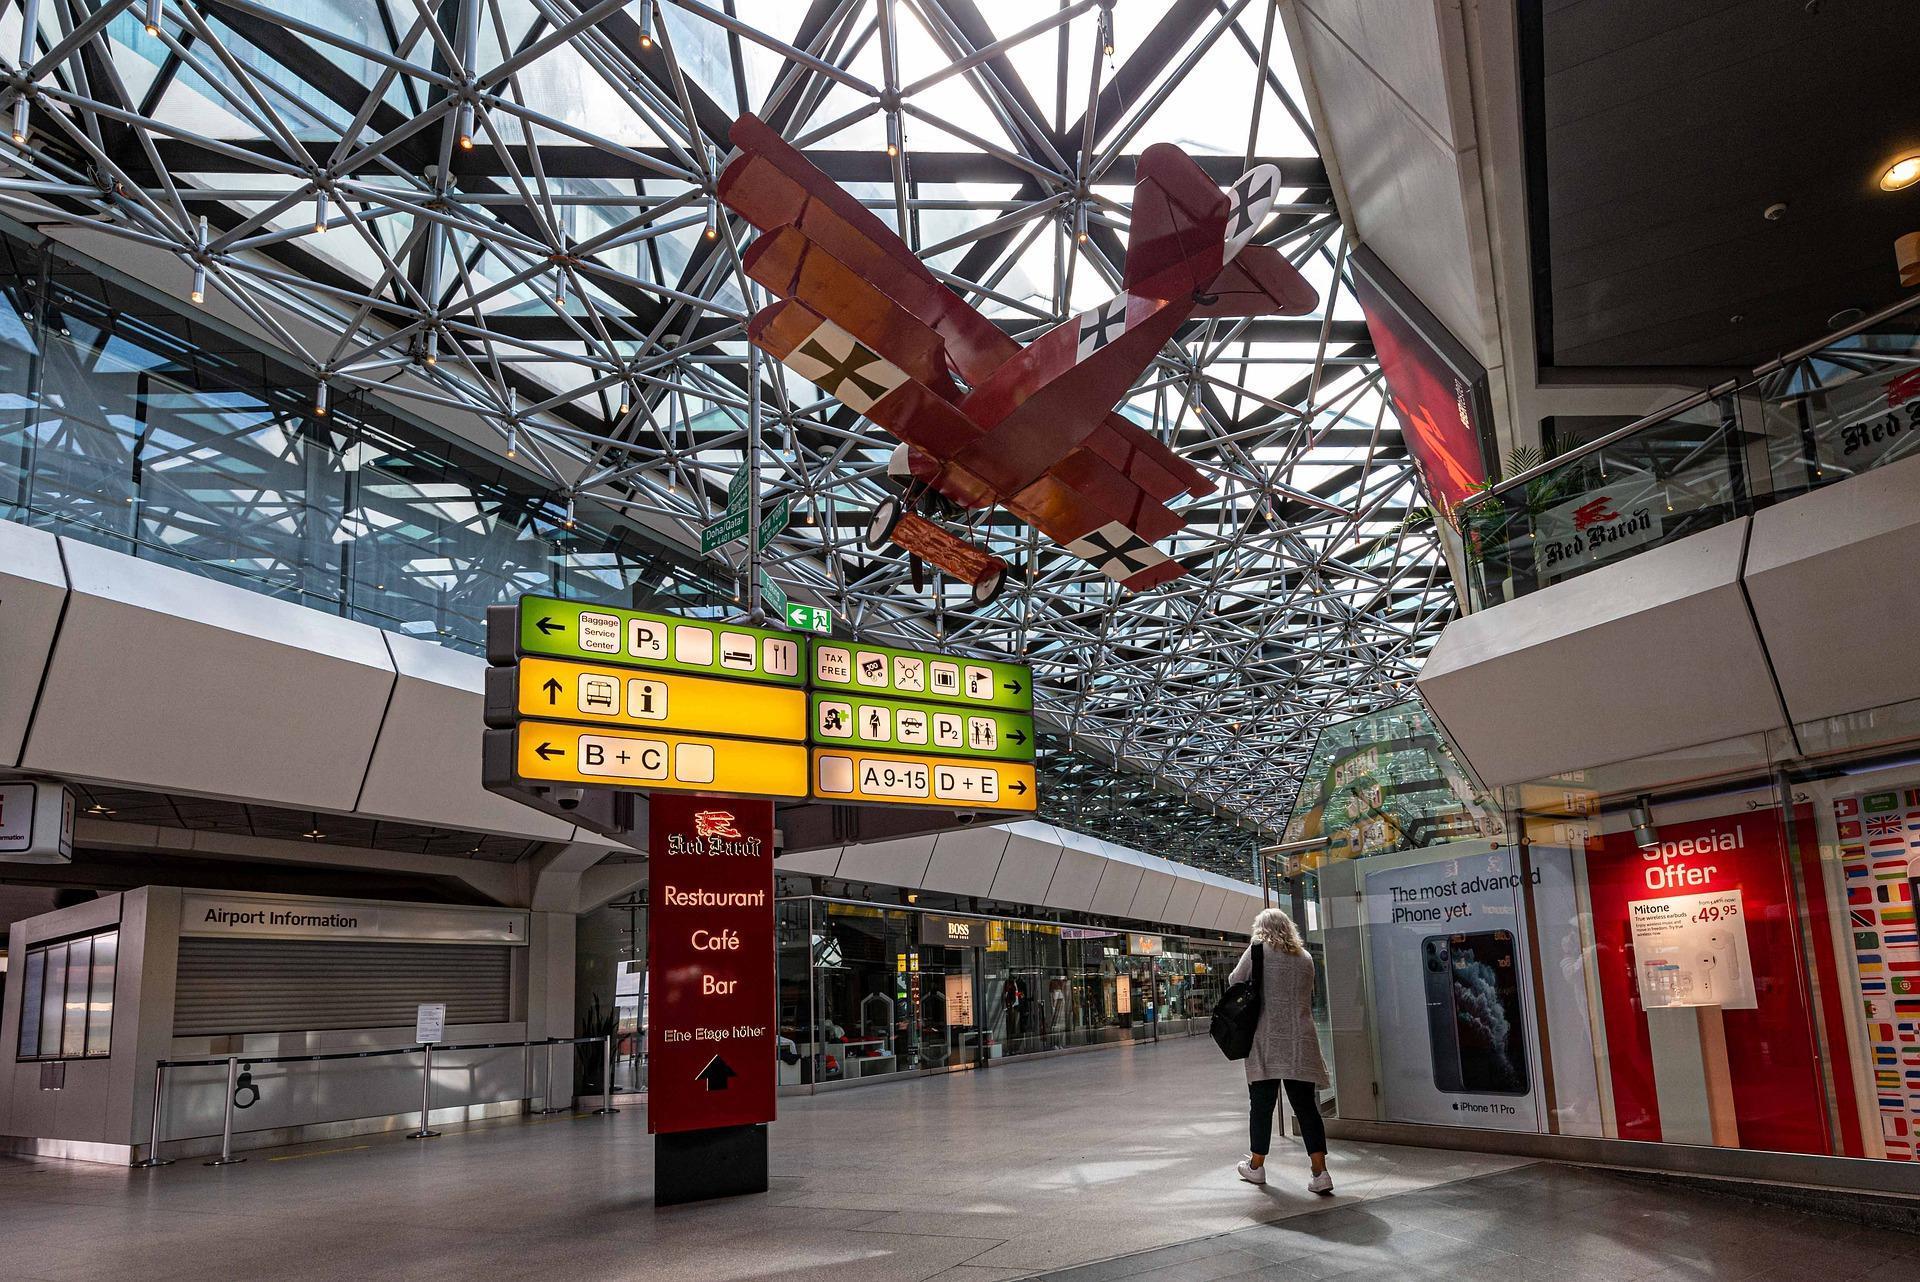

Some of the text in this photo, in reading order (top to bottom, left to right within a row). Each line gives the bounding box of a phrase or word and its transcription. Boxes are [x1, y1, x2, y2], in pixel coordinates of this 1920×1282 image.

[1841, 412, 1901, 455] Red
[706, 515, 744, 541] Doha/Qatar
[731, 529, 741, 539] km
[1544, 507, 1651, 568] Red Baron
[581, 615, 618, 627] Baggage
[584, 628, 615, 639] Service
[586, 640, 614, 650] Center
[825, 653, 843, 664] TAX
[821, 665, 847, 677] FREE
[586, 744, 604, 766] B
[641, 749, 661, 770] C
[884, 768, 926, 790] 9-15
[941, 773, 954, 791] D
[981, 775, 994, 794] E
[668, 833, 704, 856] Red
[1642, 825, 1745, 866] Special
[1645, 865, 1717, 890] Offer
[665, 886, 765, 907] Restaurant
[1390, 886, 1417, 903] The
[1420, 880, 1457, 900] most
[204, 908, 265, 927] Airport
[269, 912, 358, 929] Information
[1391, 904, 1441, 924] iPhone
[1444, 902, 1472, 922] yet.
[1634, 904, 1670, 915] Mitone
[948, 922, 969, 935] BOSS
[691, 929, 740, 951] Café
[702, 975, 737, 995] Bar
[664, 1025, 766, 1042] Eine Etage höher
[1459, 1102, 1516, 1115] iPhone 11 Pro
